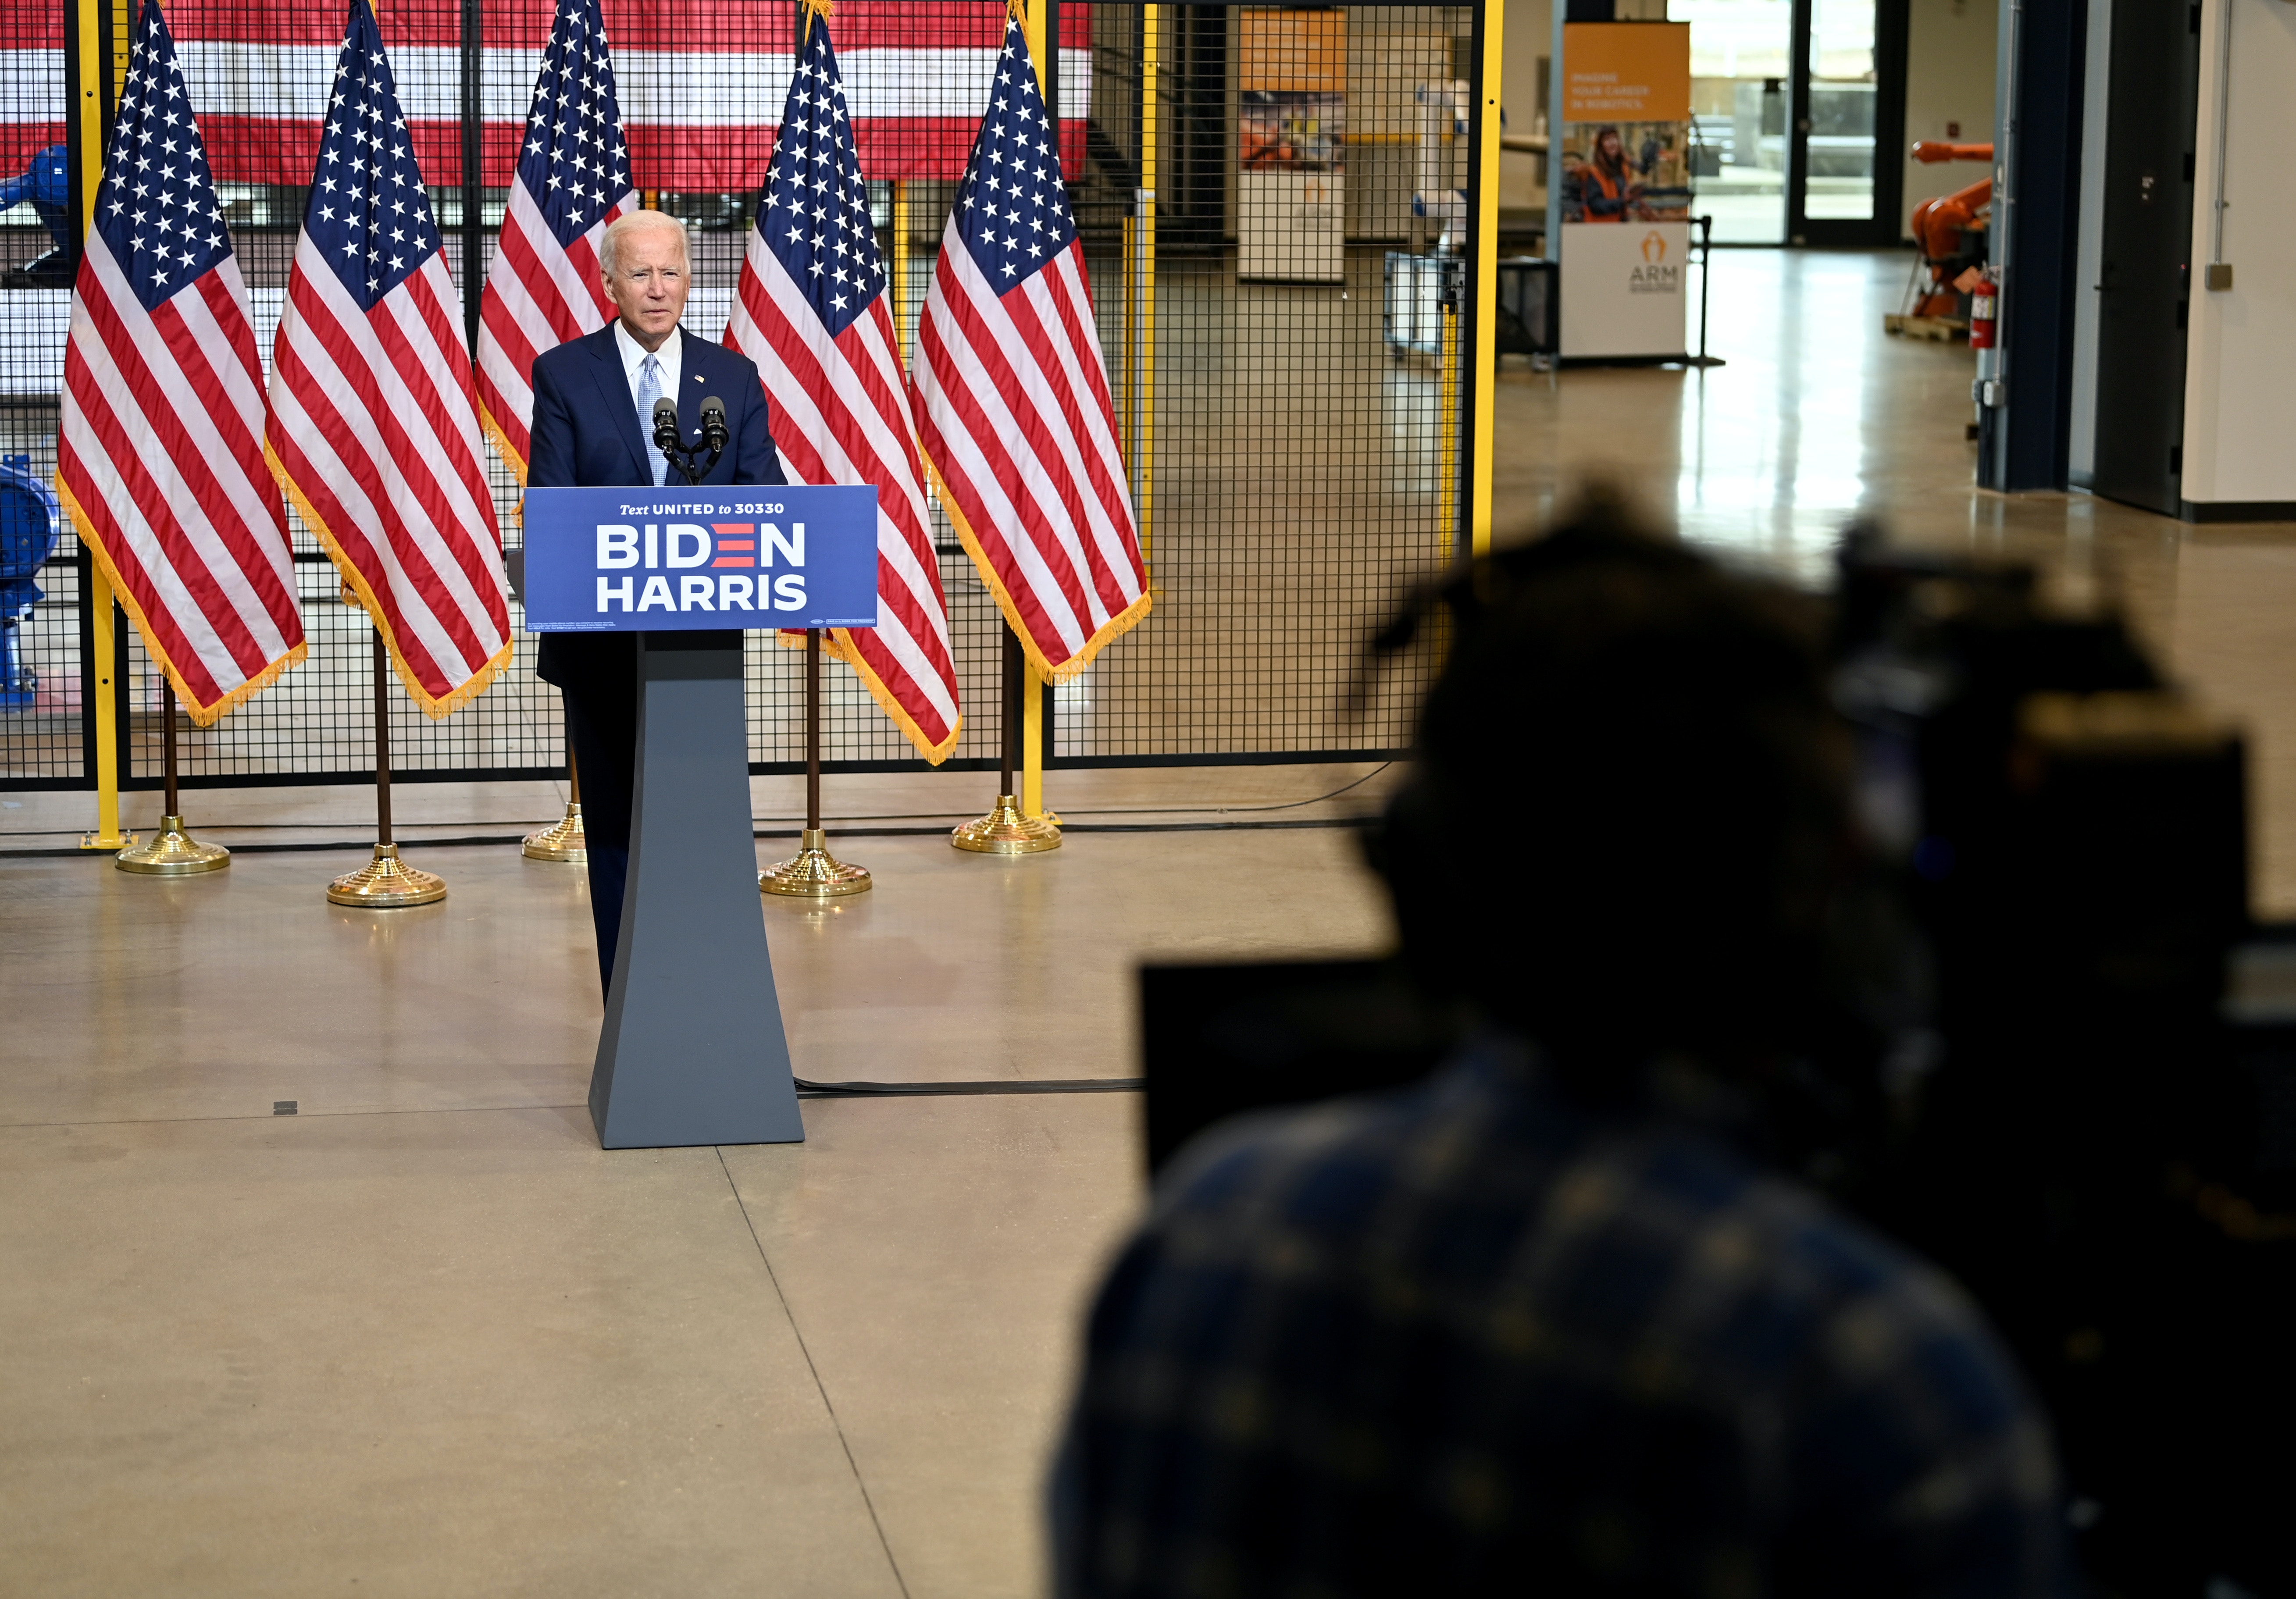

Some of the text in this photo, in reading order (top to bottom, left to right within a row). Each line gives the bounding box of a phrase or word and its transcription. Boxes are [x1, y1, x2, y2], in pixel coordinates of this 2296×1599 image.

[1629, 265, 1678, 282] ARM
[620, 503, 784, 515] Text UNITED to 30330
[597, 523, 804, 569] BIDEN
[597, 574, 806, 612] HARRIS
